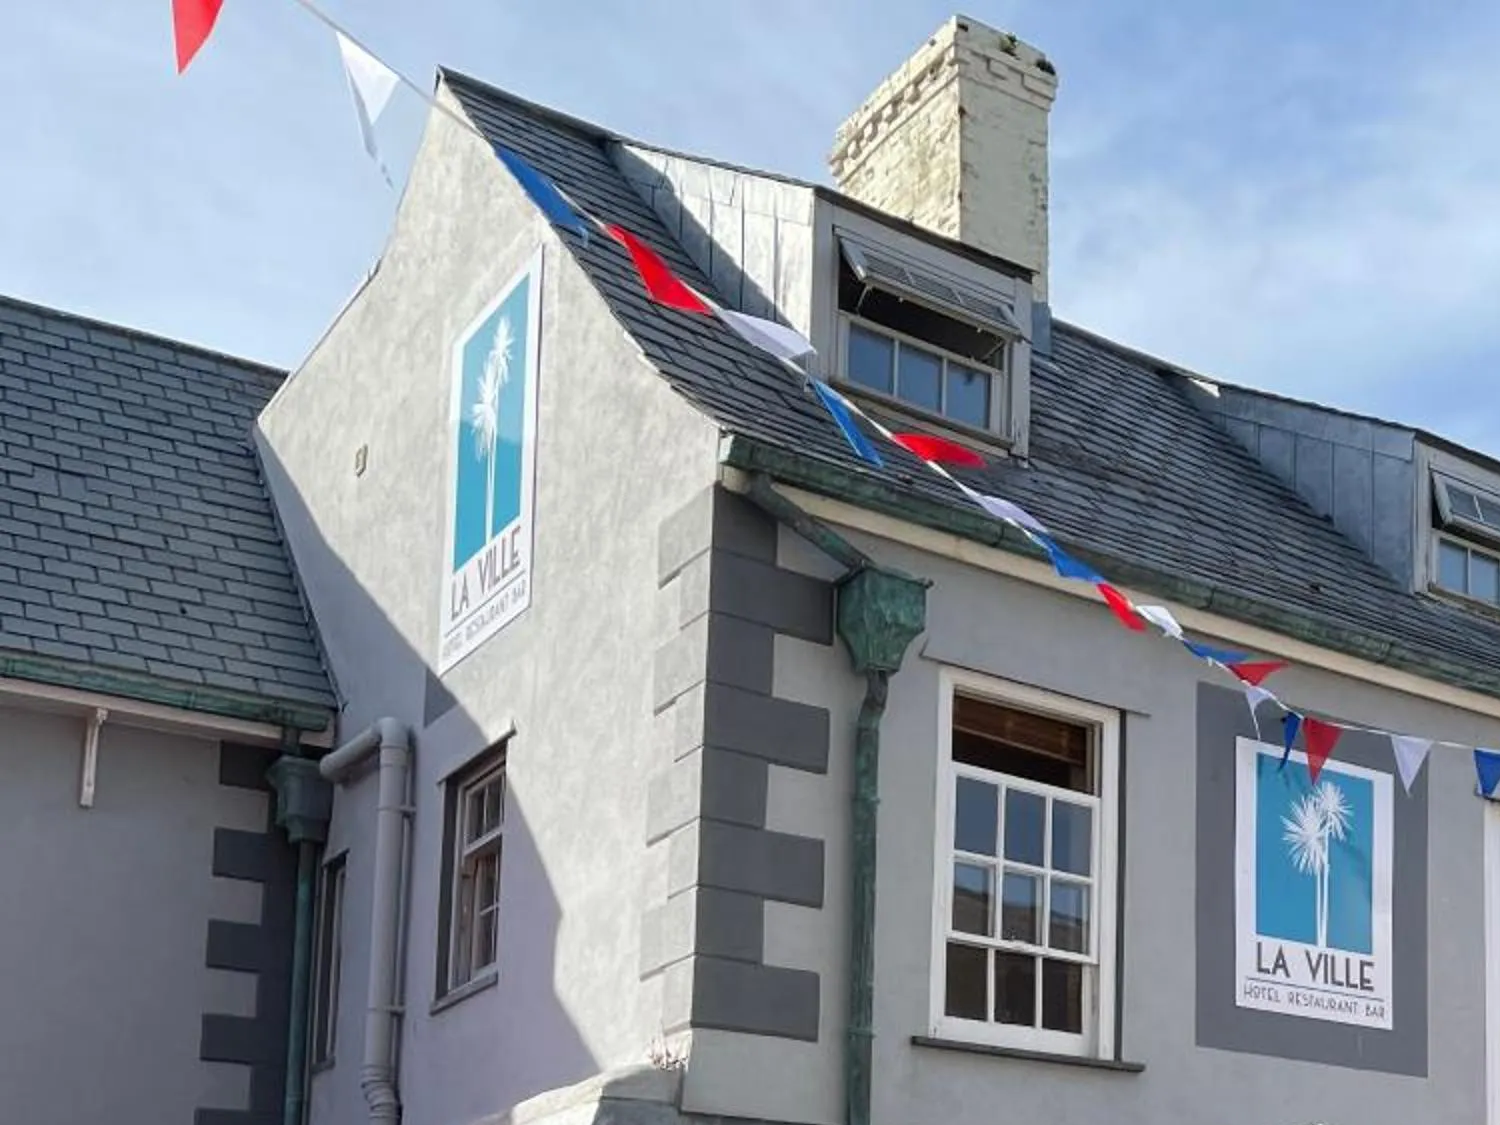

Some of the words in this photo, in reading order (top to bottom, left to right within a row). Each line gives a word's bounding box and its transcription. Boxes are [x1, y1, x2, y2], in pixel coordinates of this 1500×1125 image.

[452, 573, 469, 621] LA
[478, 525, 521, 594] VILLE
[1257, 941, 1291, 978] LA
[1304, 949, 1374, 992] VILLE
[1244, 983, 1281, 1002] HOTEL
[1288, 991, 1358, 1014] RESTAURANT
[1365, 1004, 1385, 1019] BAR
